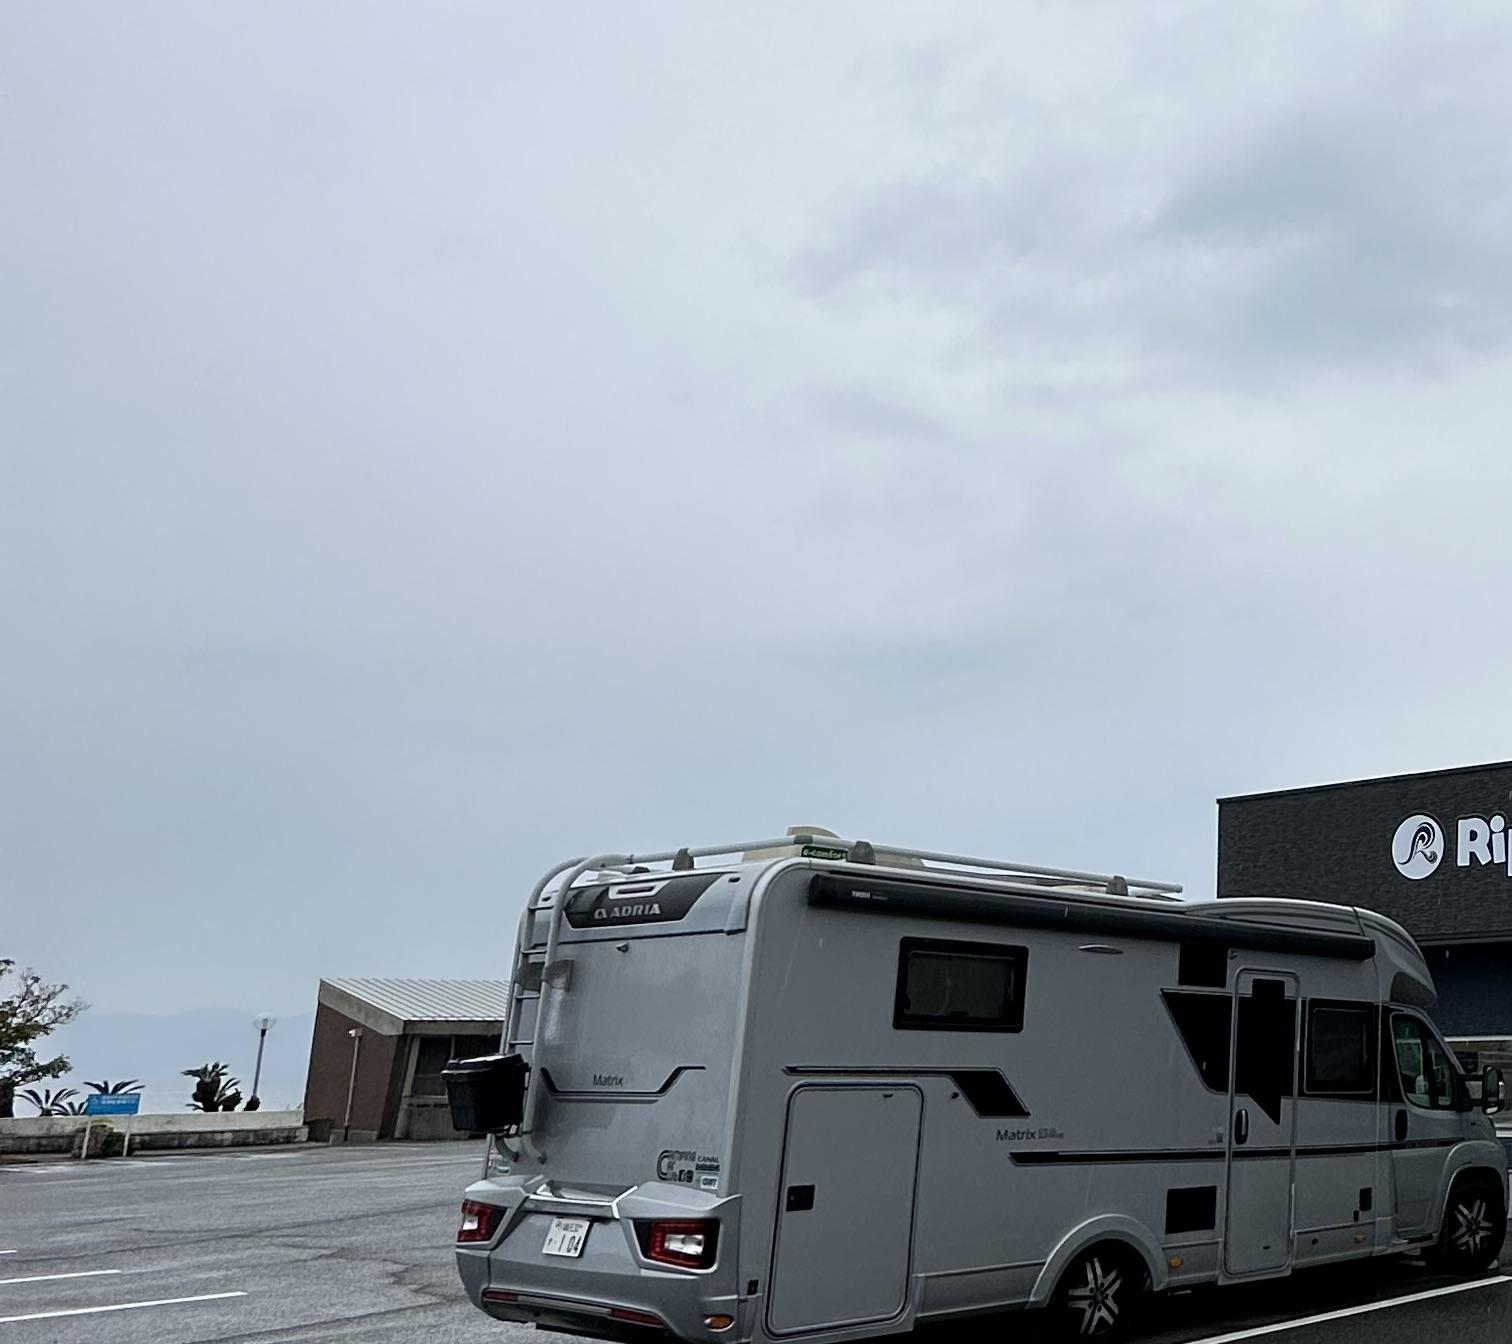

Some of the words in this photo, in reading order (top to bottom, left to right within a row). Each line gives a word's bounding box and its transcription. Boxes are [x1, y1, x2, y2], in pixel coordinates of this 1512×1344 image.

[610, 903, 661, 918] ADRIA
[593, 1074, 624, 1087] Matrix
[996, 1128, 1036, 1141] Matrix
